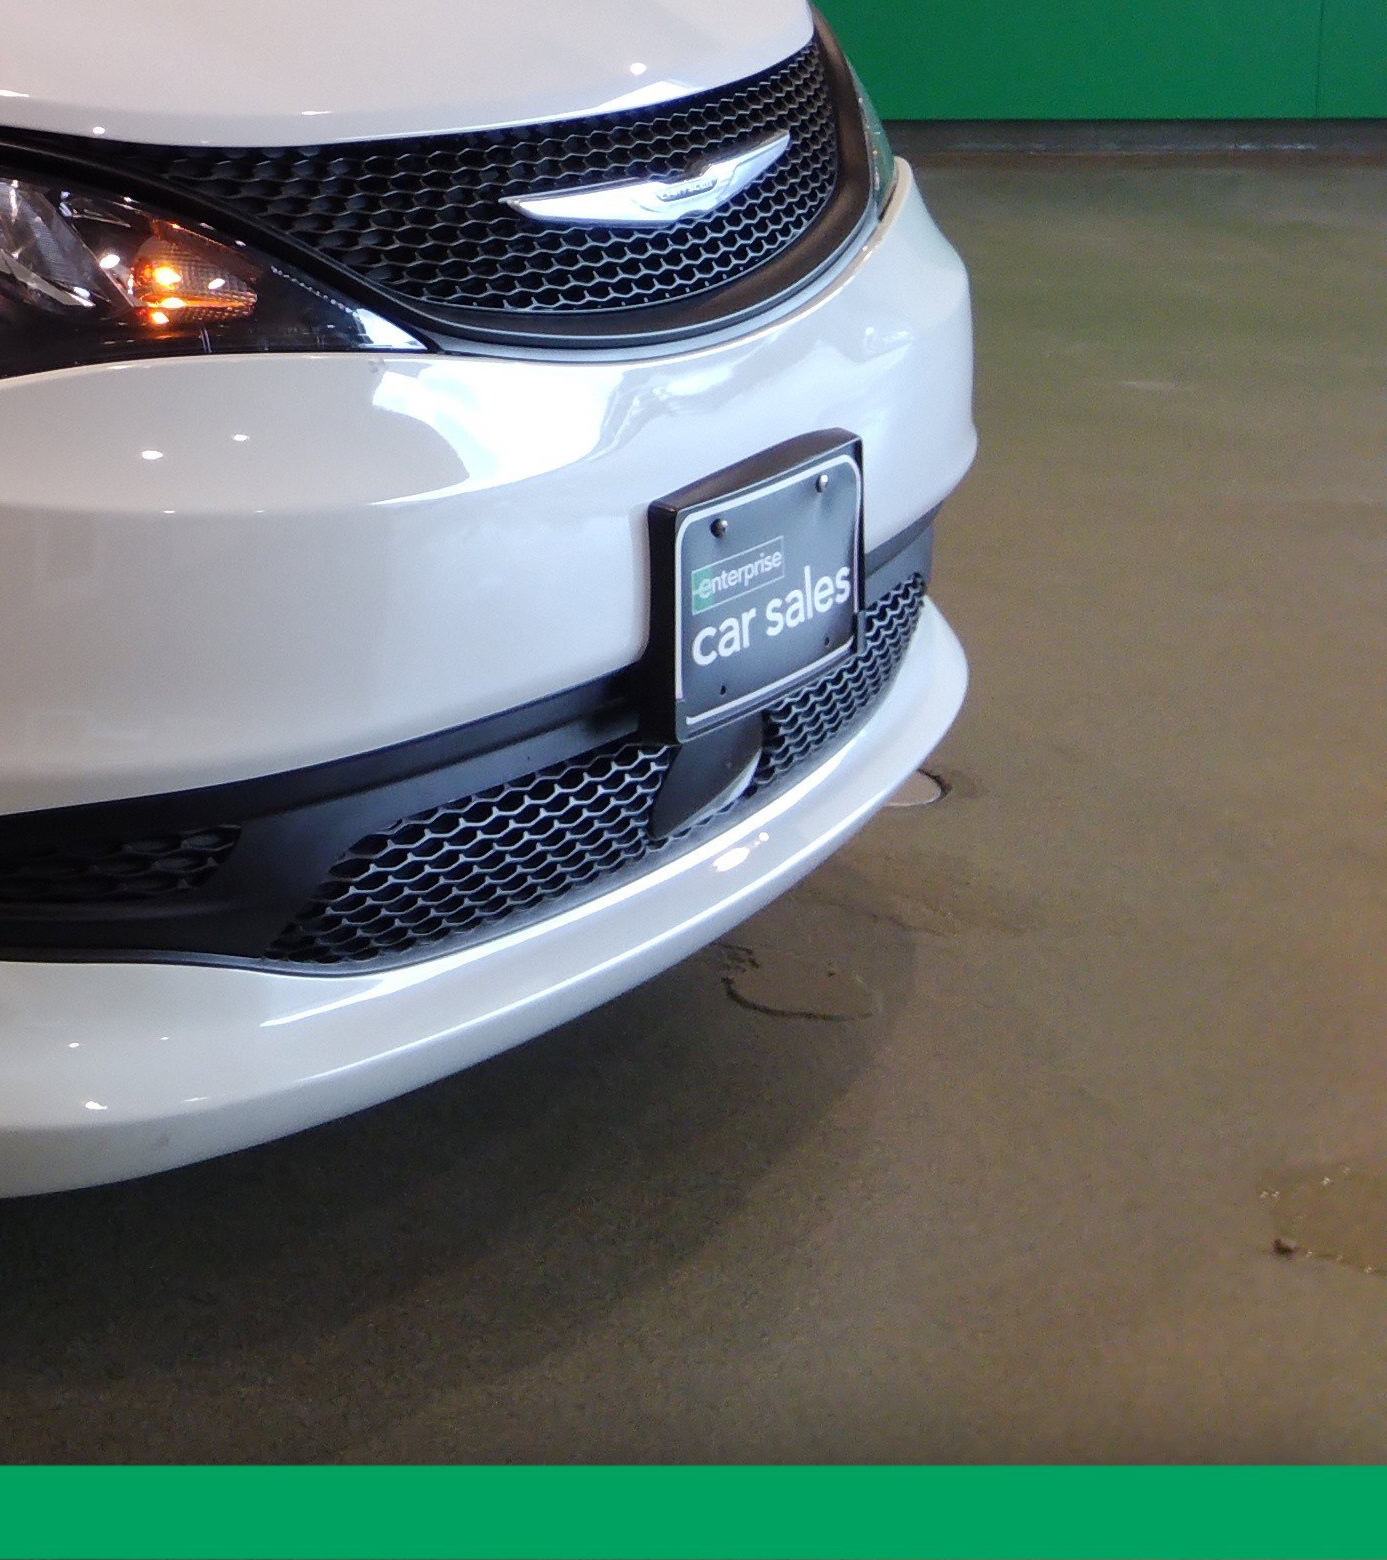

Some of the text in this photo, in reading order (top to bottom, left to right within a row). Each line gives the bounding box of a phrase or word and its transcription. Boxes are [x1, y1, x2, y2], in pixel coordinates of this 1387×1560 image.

[698, 549, 784, 598] enterprise
[691, 565, 851, 667] car sales
